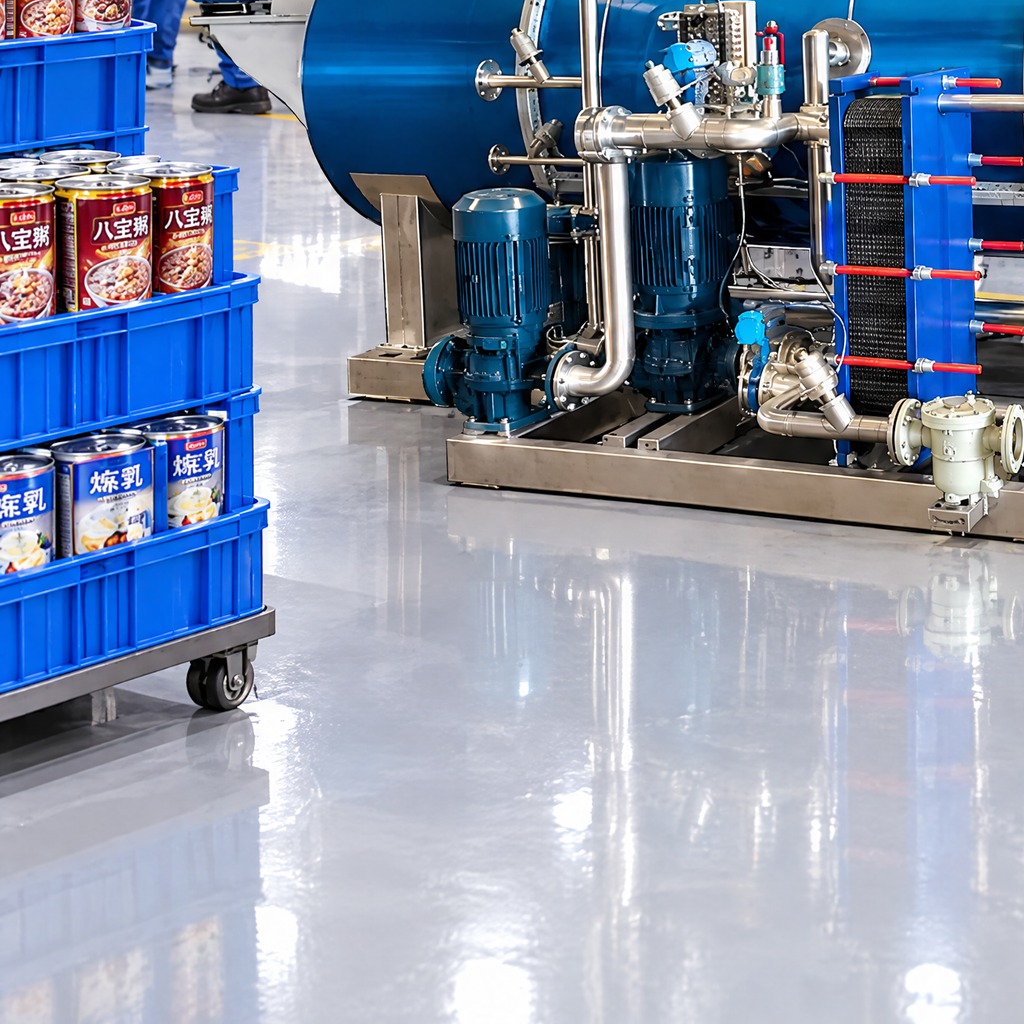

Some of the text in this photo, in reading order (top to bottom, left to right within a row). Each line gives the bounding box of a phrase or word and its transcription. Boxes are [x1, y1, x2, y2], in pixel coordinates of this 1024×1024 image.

[93, 214, 149, 241] 八宝粥
[164, 204, 213, 230] 八宝粥
